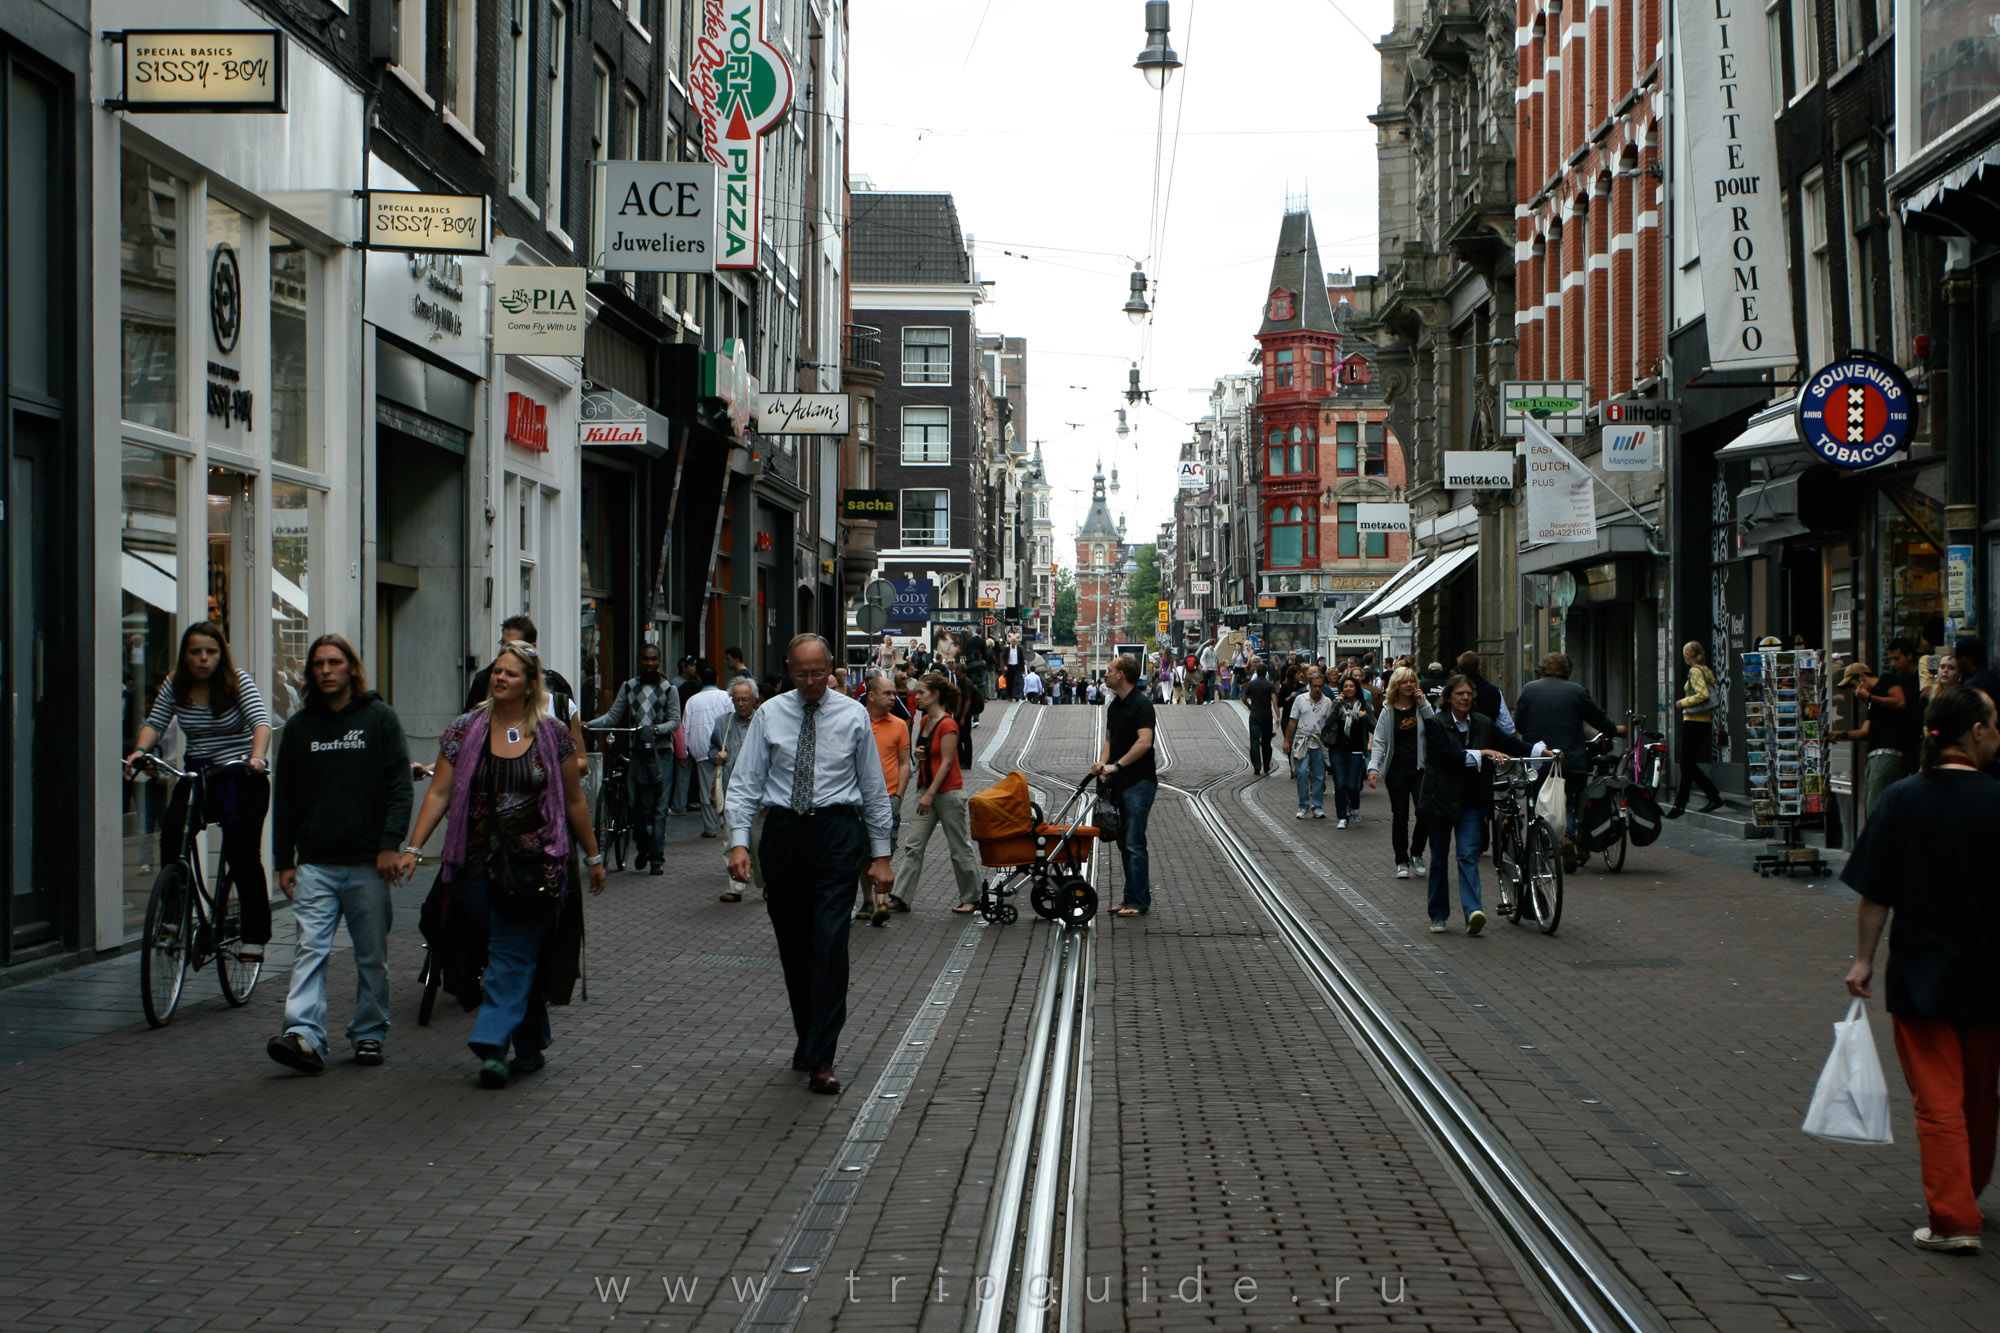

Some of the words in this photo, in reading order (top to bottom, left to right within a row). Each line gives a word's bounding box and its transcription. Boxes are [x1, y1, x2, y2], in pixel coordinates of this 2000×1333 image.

[136, 48, 185, 56] SPECIAL
[190, 48, 232, 56] BASICS
[724, 5, 753, 120] YORK
[1714, 175, 1760, 202] pour
[618, 181, 701, 217] ACE
[726, 149, 748, 258] PIZZA
[377, 204, 414, 212] SPECIAL
[418, 206, 450, 214] BASICS
[612, 231, 705, 253] Juweliers
[1731, 206, 1762, 351] ROMEO
[533, 288, 577, 310] PIA
[508, 322, 531, 330] Come
[533, 322, 545, 331] Fly
[547, 323, 564, 331] With
[566, 323, 577, 331] Us
[1811, 364, 1901, 399] SOUVENIRS
[767, 396, 789, 415] dr.
[780, 396, 840, 431] Adam's
[1625, 405, 1671, 421] iittala
[1803, 411, 1822, 419] ANNO
[1530, 446, 1553, 454] EASY
[1816, 433, 1896, 462] TOBACCO
[1531, 461, 1570, 471] DUTCH
[1608, 457, 1648, 466] Manpower
[1448, 474, 1510, 485] metz&co.
[1532, 478, 1554, 487] PLUS
[847, 499, 894, 511] sacha
[1360, 521, 1408, 530] metz&co.
[1539, 528, 1592, 538] 020-4221906
[1192, 583, 1209, 592] POLEN
[310, 739, 366, 752] Boxfresh
